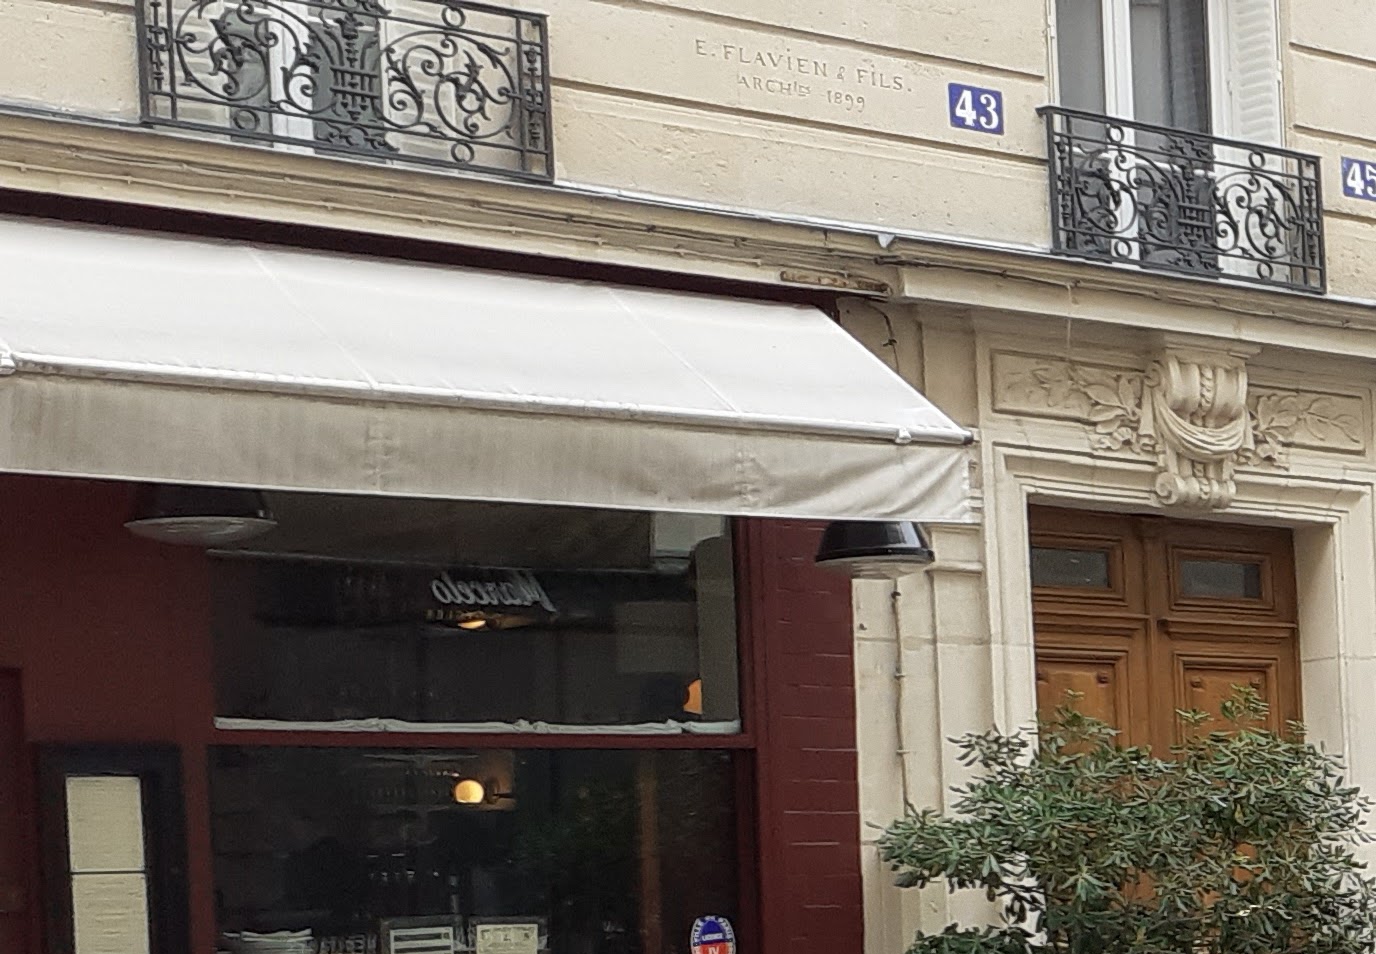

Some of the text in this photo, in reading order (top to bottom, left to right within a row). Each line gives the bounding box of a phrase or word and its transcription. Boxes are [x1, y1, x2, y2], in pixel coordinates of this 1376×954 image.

[696, 39, 716, 57] E.
[723, 44, 828, 77] FLAVIEN
[856, 63, 913, 92] FILS.
[827, 89, 865, 113] 1899
[954, 89, 1000, 129] 43
